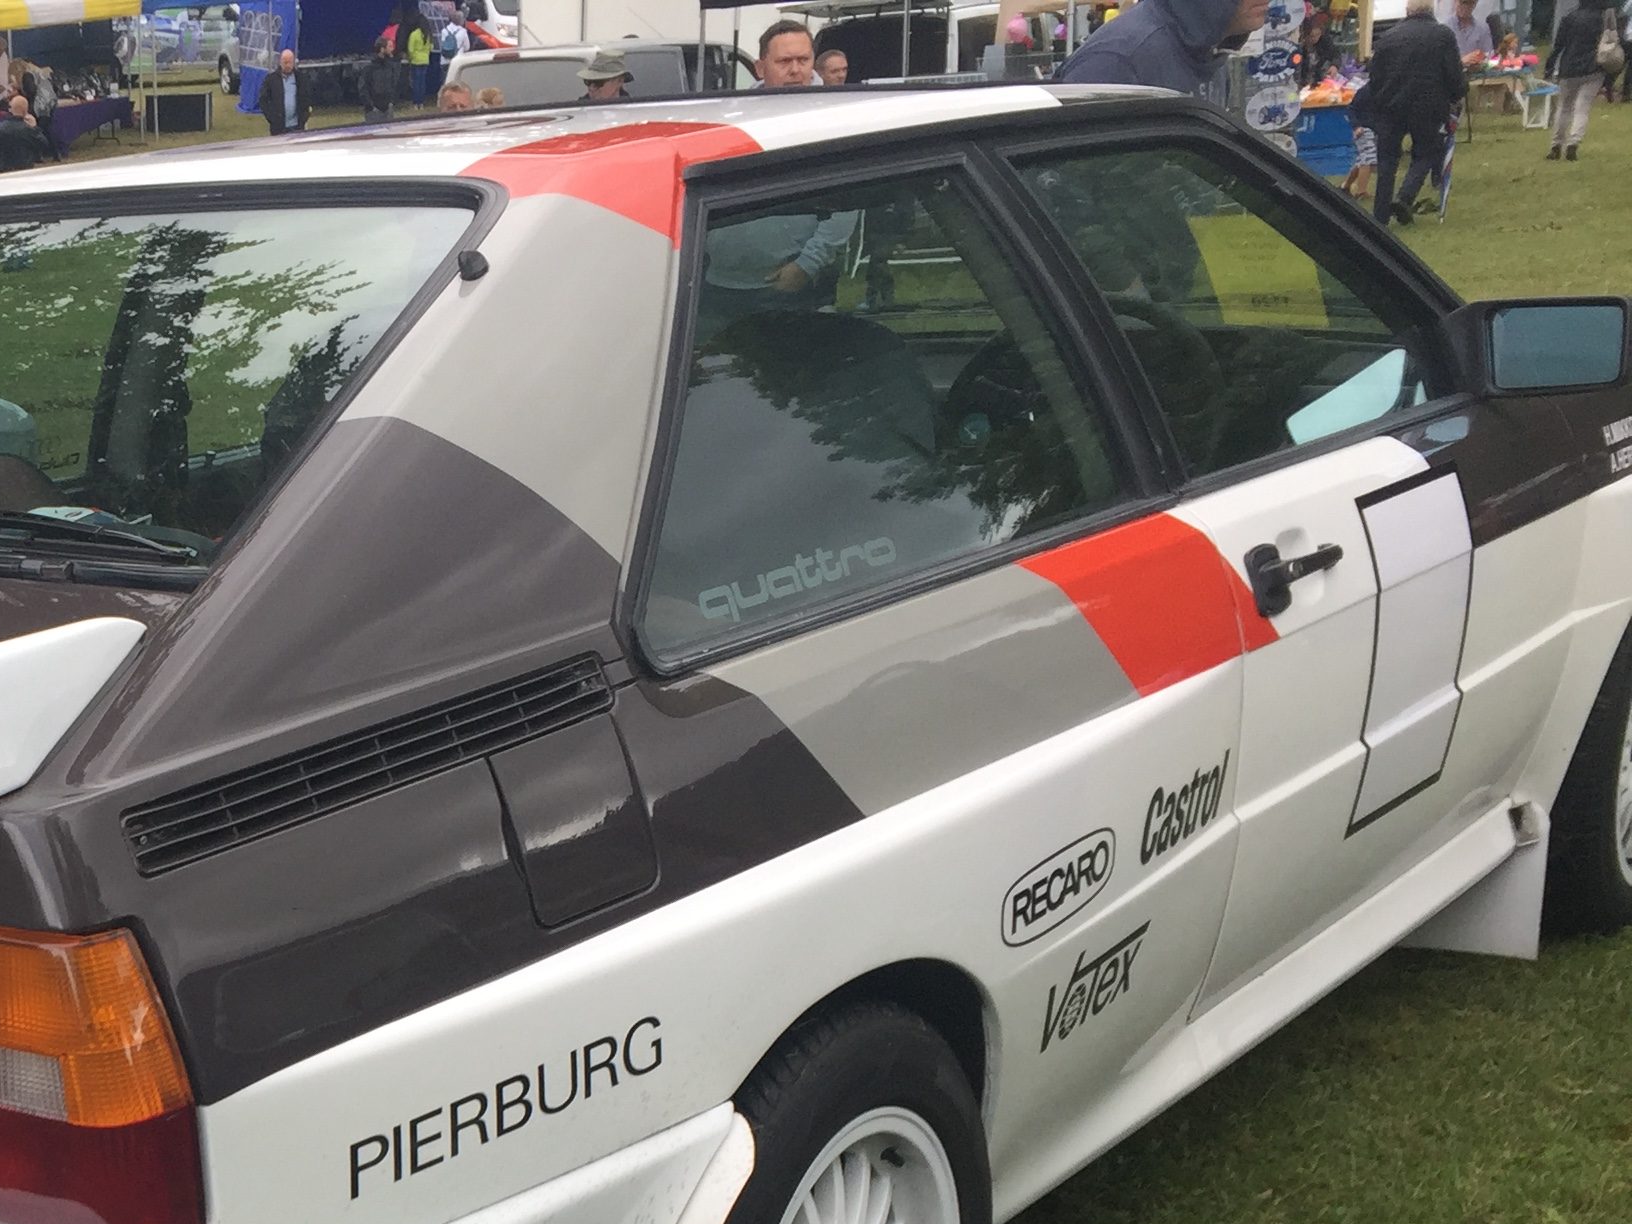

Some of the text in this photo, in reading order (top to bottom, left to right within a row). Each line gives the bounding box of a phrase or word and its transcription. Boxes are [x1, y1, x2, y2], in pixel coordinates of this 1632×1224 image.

[698, 536, 897, 622] quattro
[1140, 748, 1231, 866] Castrol
[1011, 840, 1110, 936] RECARO
[349, 1016, 662, 1201] PIERBURG
